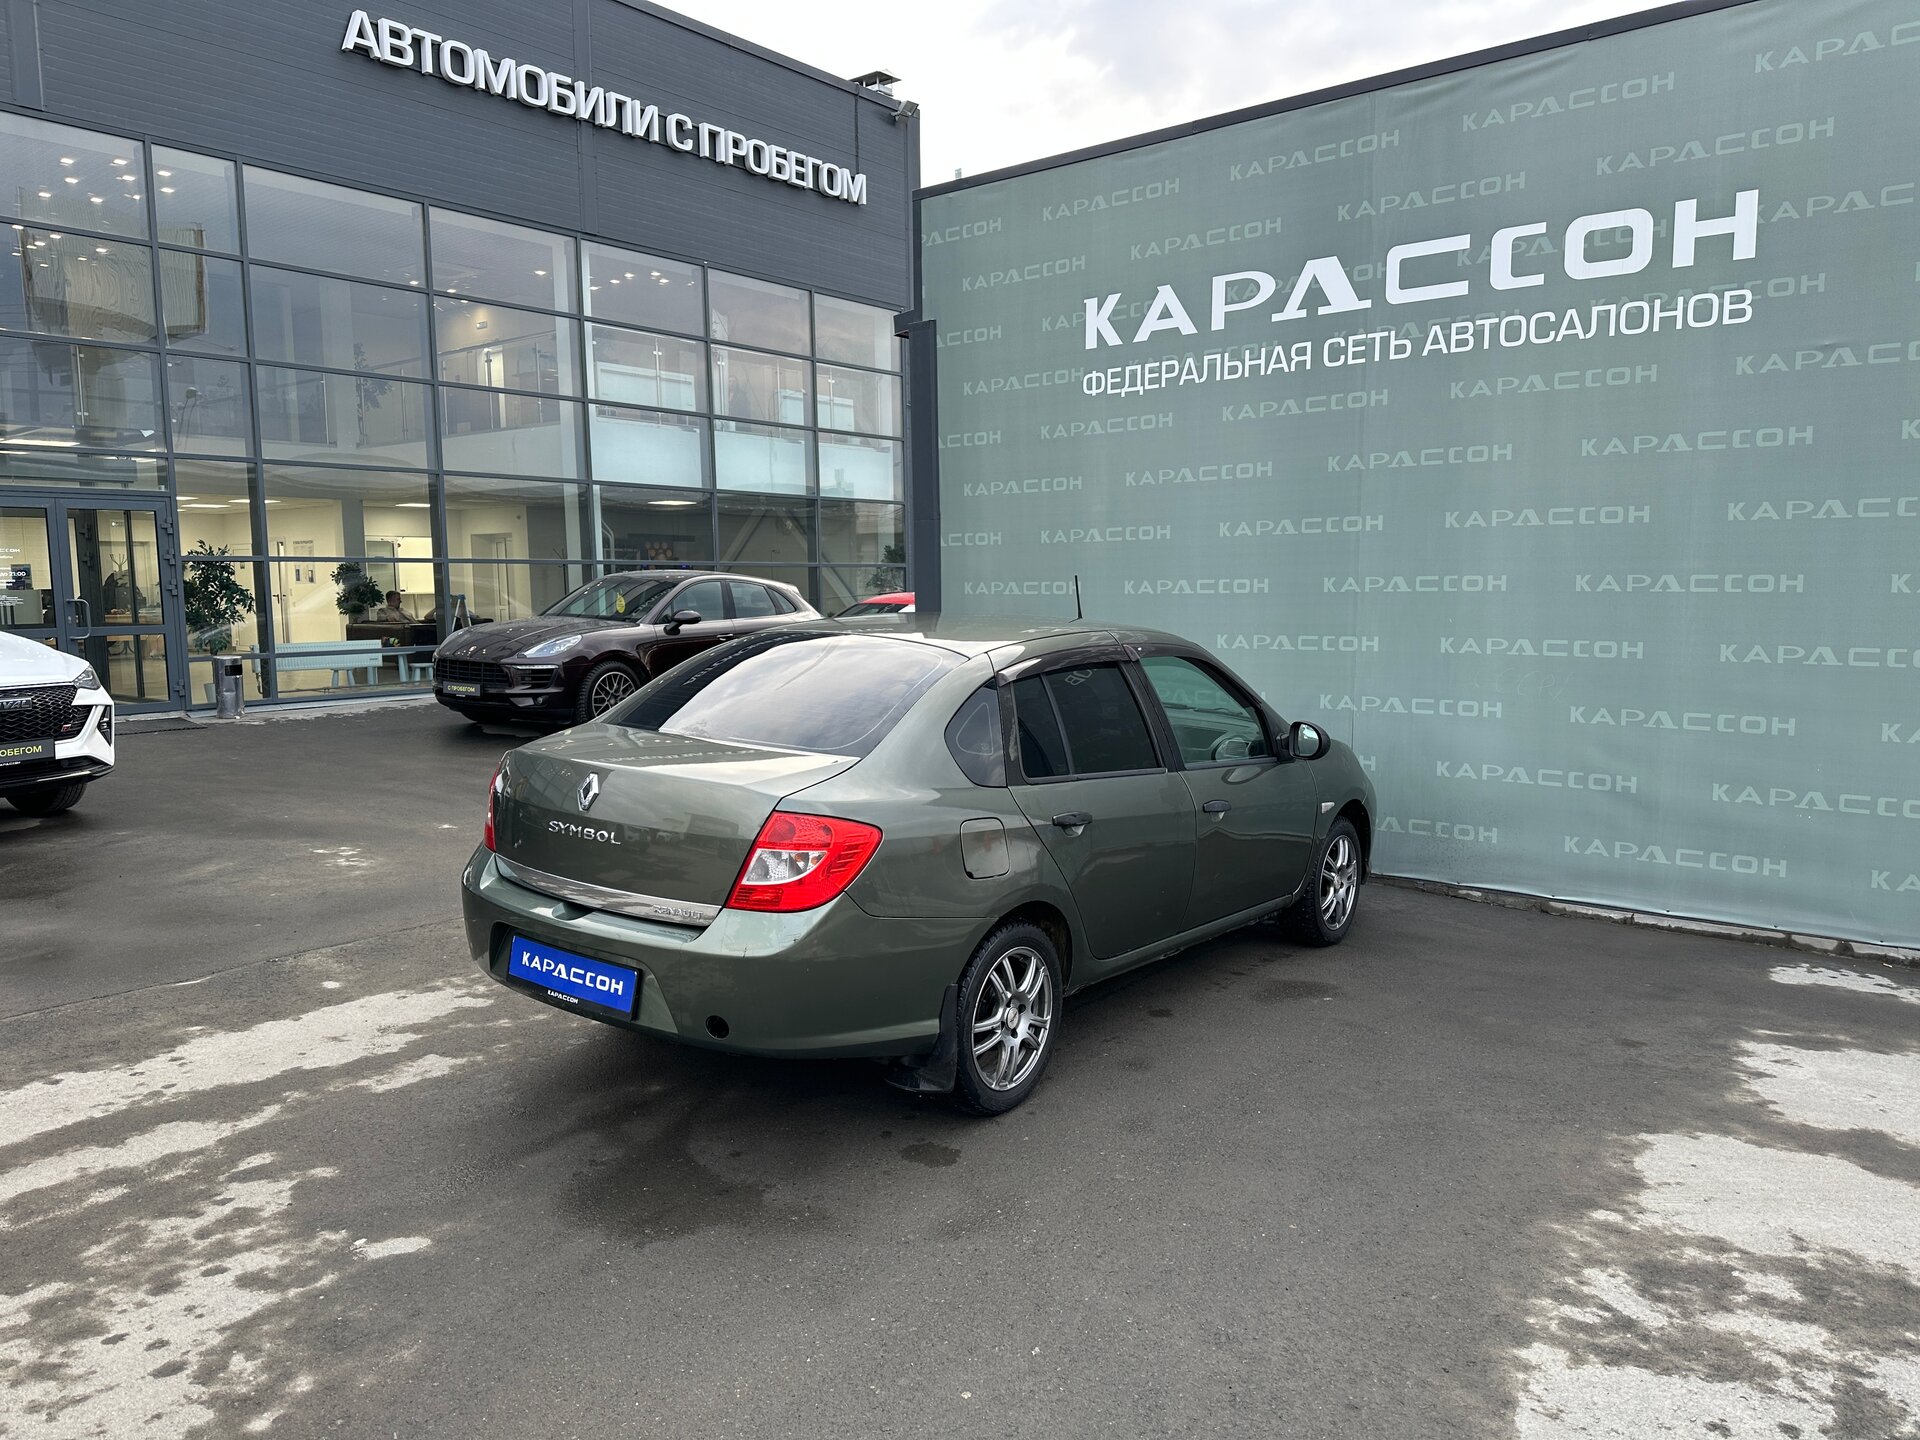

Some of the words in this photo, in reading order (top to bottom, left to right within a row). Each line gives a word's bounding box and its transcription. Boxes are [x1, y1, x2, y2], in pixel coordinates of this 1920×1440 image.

[342, 9, 659, 144] АВТОМОБИЛИ
[666, 113, 694, 152] С
[700, 122, 867, 206] ПРОБЕГОМ
[1082, 341, 1312, 397] ФЕДЕРАЛЬНАЯ
[1323, 331, 1412, 368] СЕТЬ
[1422, 289, 1753, 357] АВТОСАЛОНОВ
[0, 701, 27, 710] VAL
[548, 819, 621, 846] SYMBOL
[652, 904, 704, 919] RENAULT
